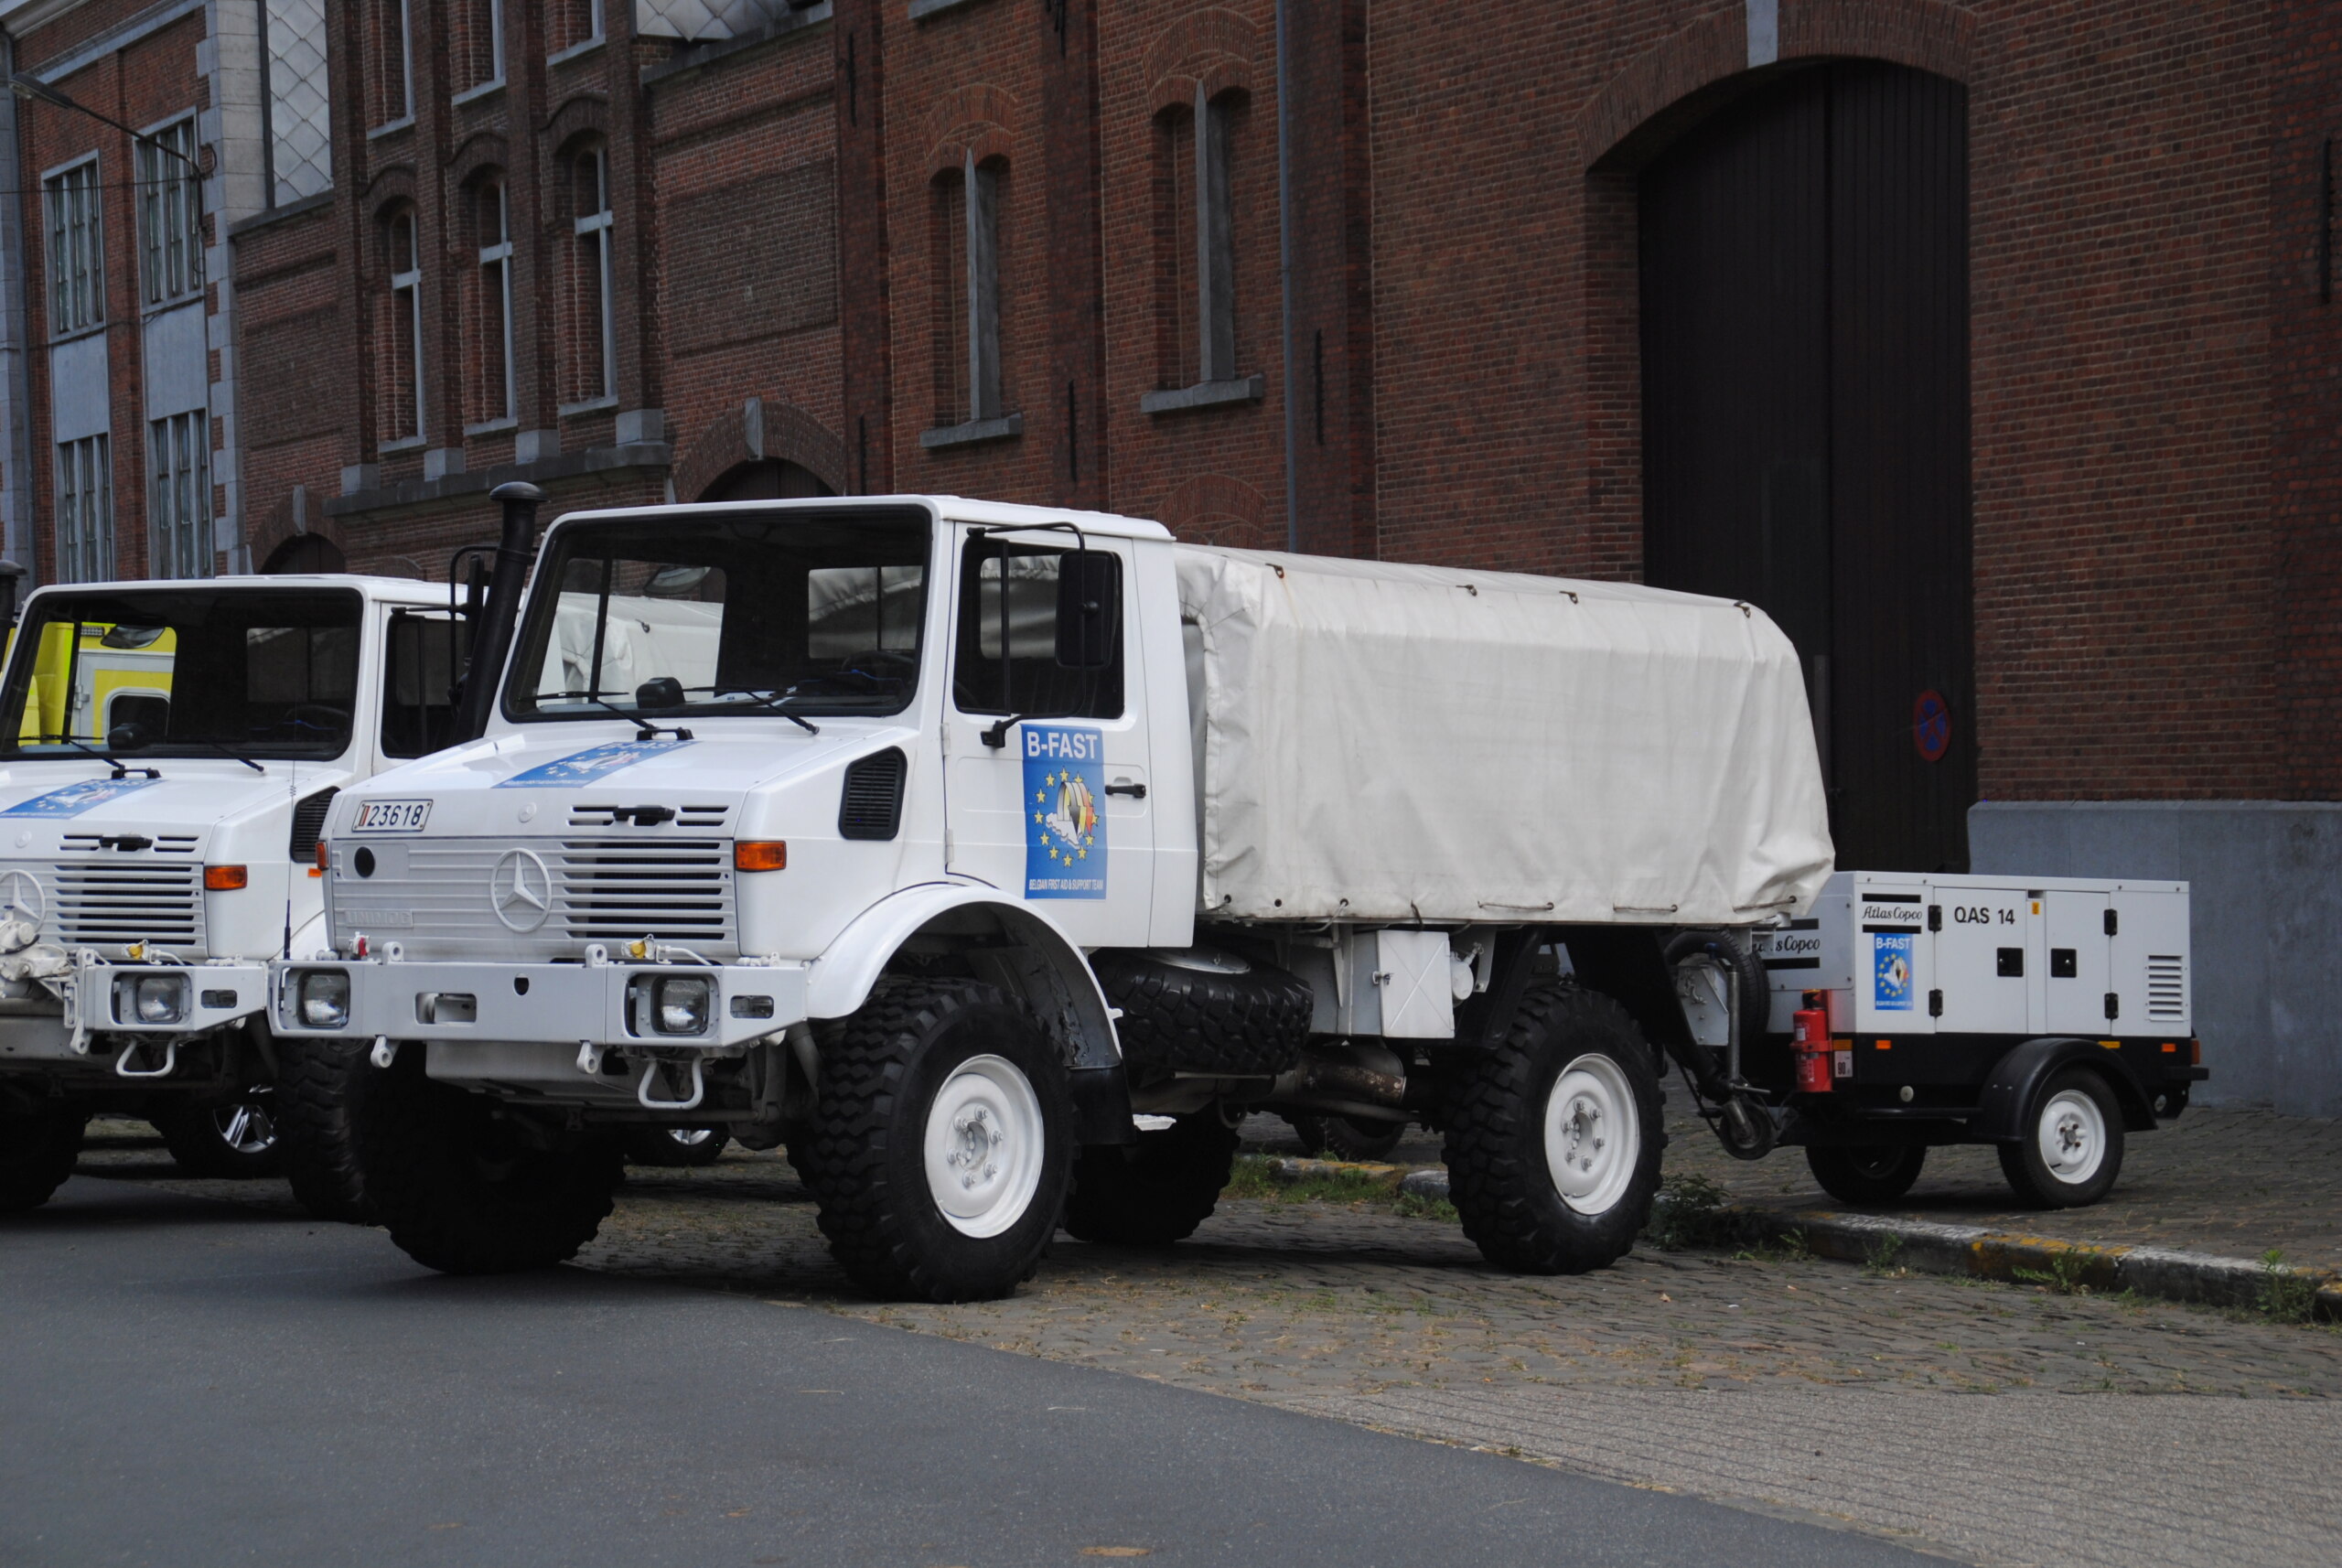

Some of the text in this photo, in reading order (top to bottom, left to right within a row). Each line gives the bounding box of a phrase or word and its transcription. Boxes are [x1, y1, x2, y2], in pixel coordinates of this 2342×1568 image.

[1026, 731, 1098, 759] B-FAST
[367, 804, 424, 826] 23618
[1028, 878, 1047, 890] BELGIAN
[1048, 879, 1060, 890] FIRST
[1060, 879, 1069, 890] AID
[1072, 879, 1091, 890] SUPPORT
[1091, 879, 1103, 890] TEAM
[1862, 906, 1922, 922] Atlas Copco
[1954, 906, 2015, 925] QAS 14
[1784, 935, 1821, 954] Copco
[1875, 937, 1910, 950] B-FAST
